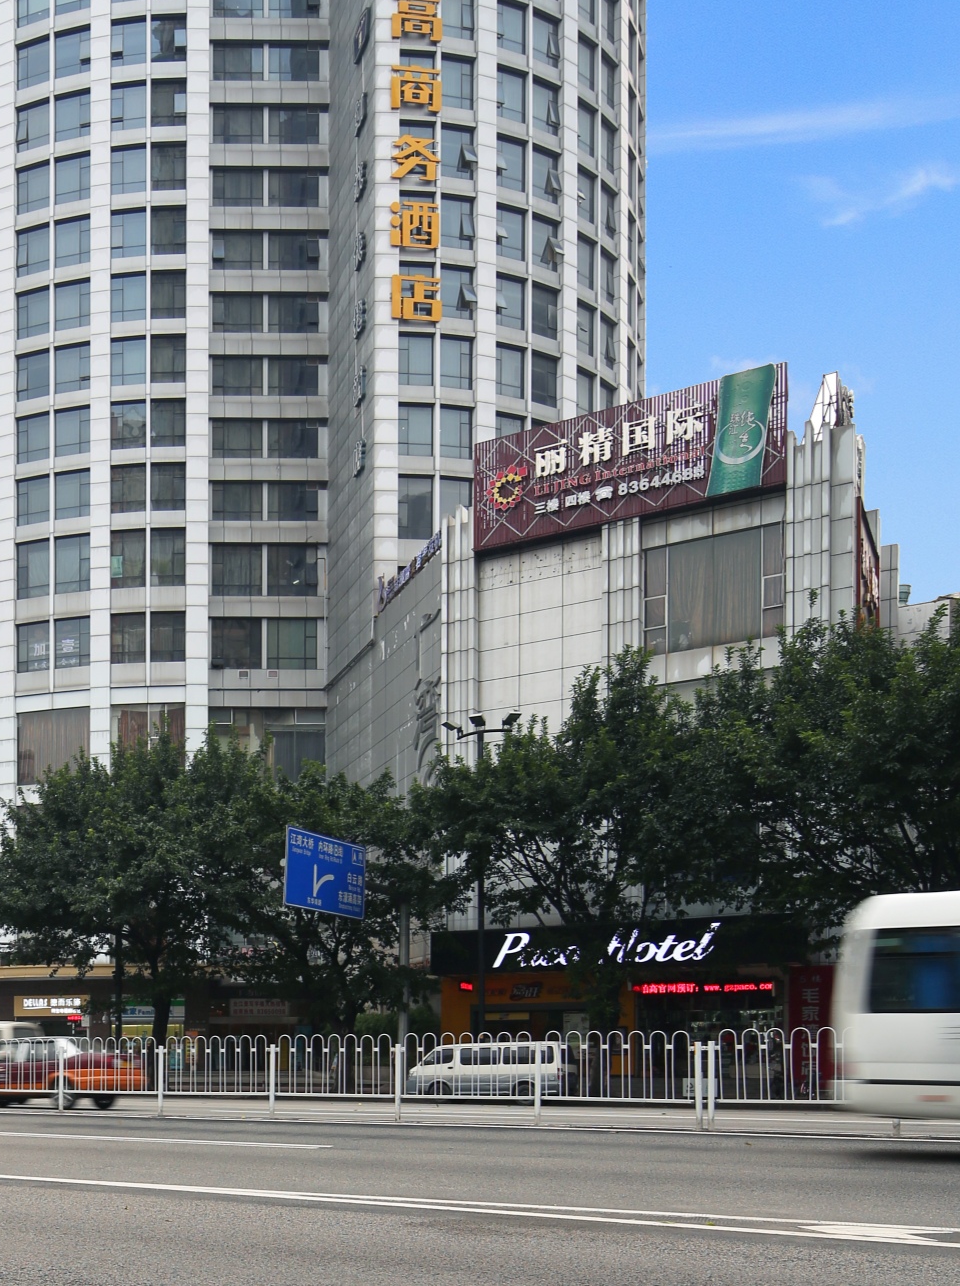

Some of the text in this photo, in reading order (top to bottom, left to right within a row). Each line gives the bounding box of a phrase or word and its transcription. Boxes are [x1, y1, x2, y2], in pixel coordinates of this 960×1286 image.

[533, 404, 705, 478] 丽精国际
[595, 445, 706, 482] International
[534, 465, 705, 515] 三楼 四楼 83644688
